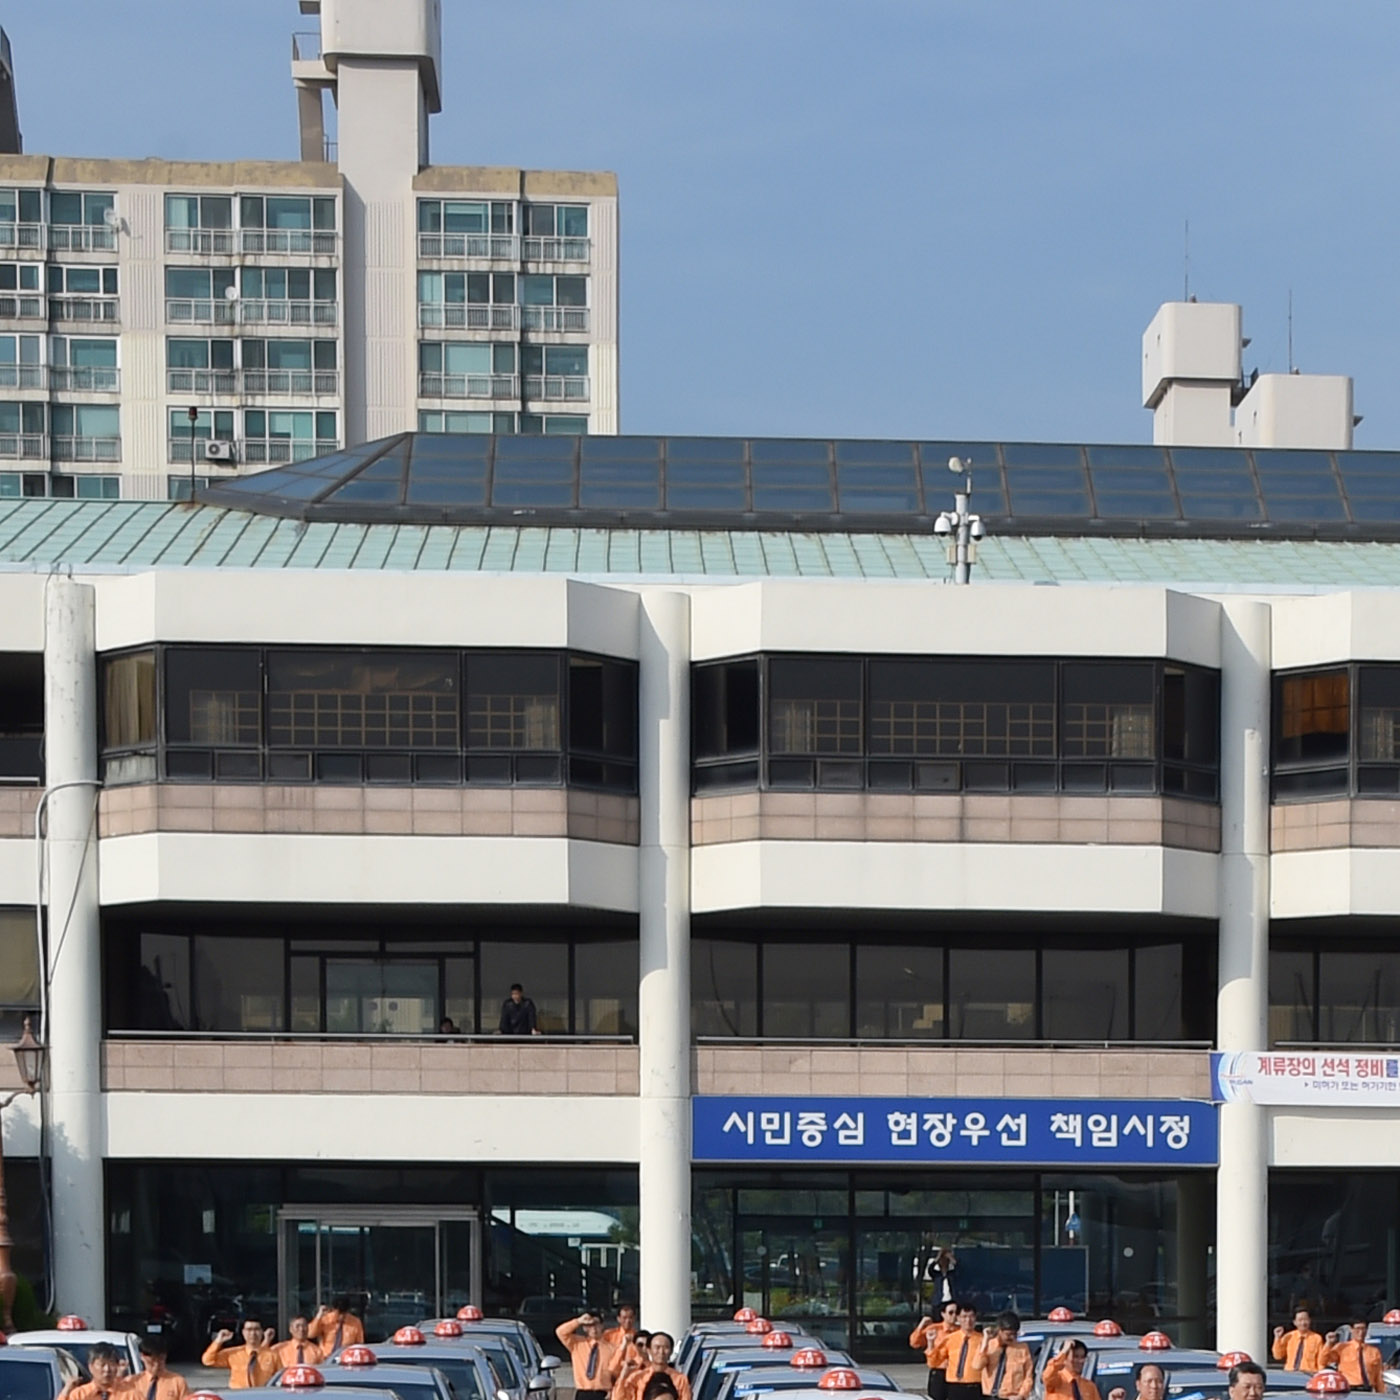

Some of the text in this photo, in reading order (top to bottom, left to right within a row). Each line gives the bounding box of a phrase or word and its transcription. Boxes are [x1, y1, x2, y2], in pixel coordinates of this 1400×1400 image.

[1257, 1057, 1316, 1077] 계류장의
[1321, 1058, 1350, 1077] 선석
[1355, 1058, 1398, 1078] 정비를
[722, 1111, 1191, 1149] 시민중심 현장우선 책임시정
